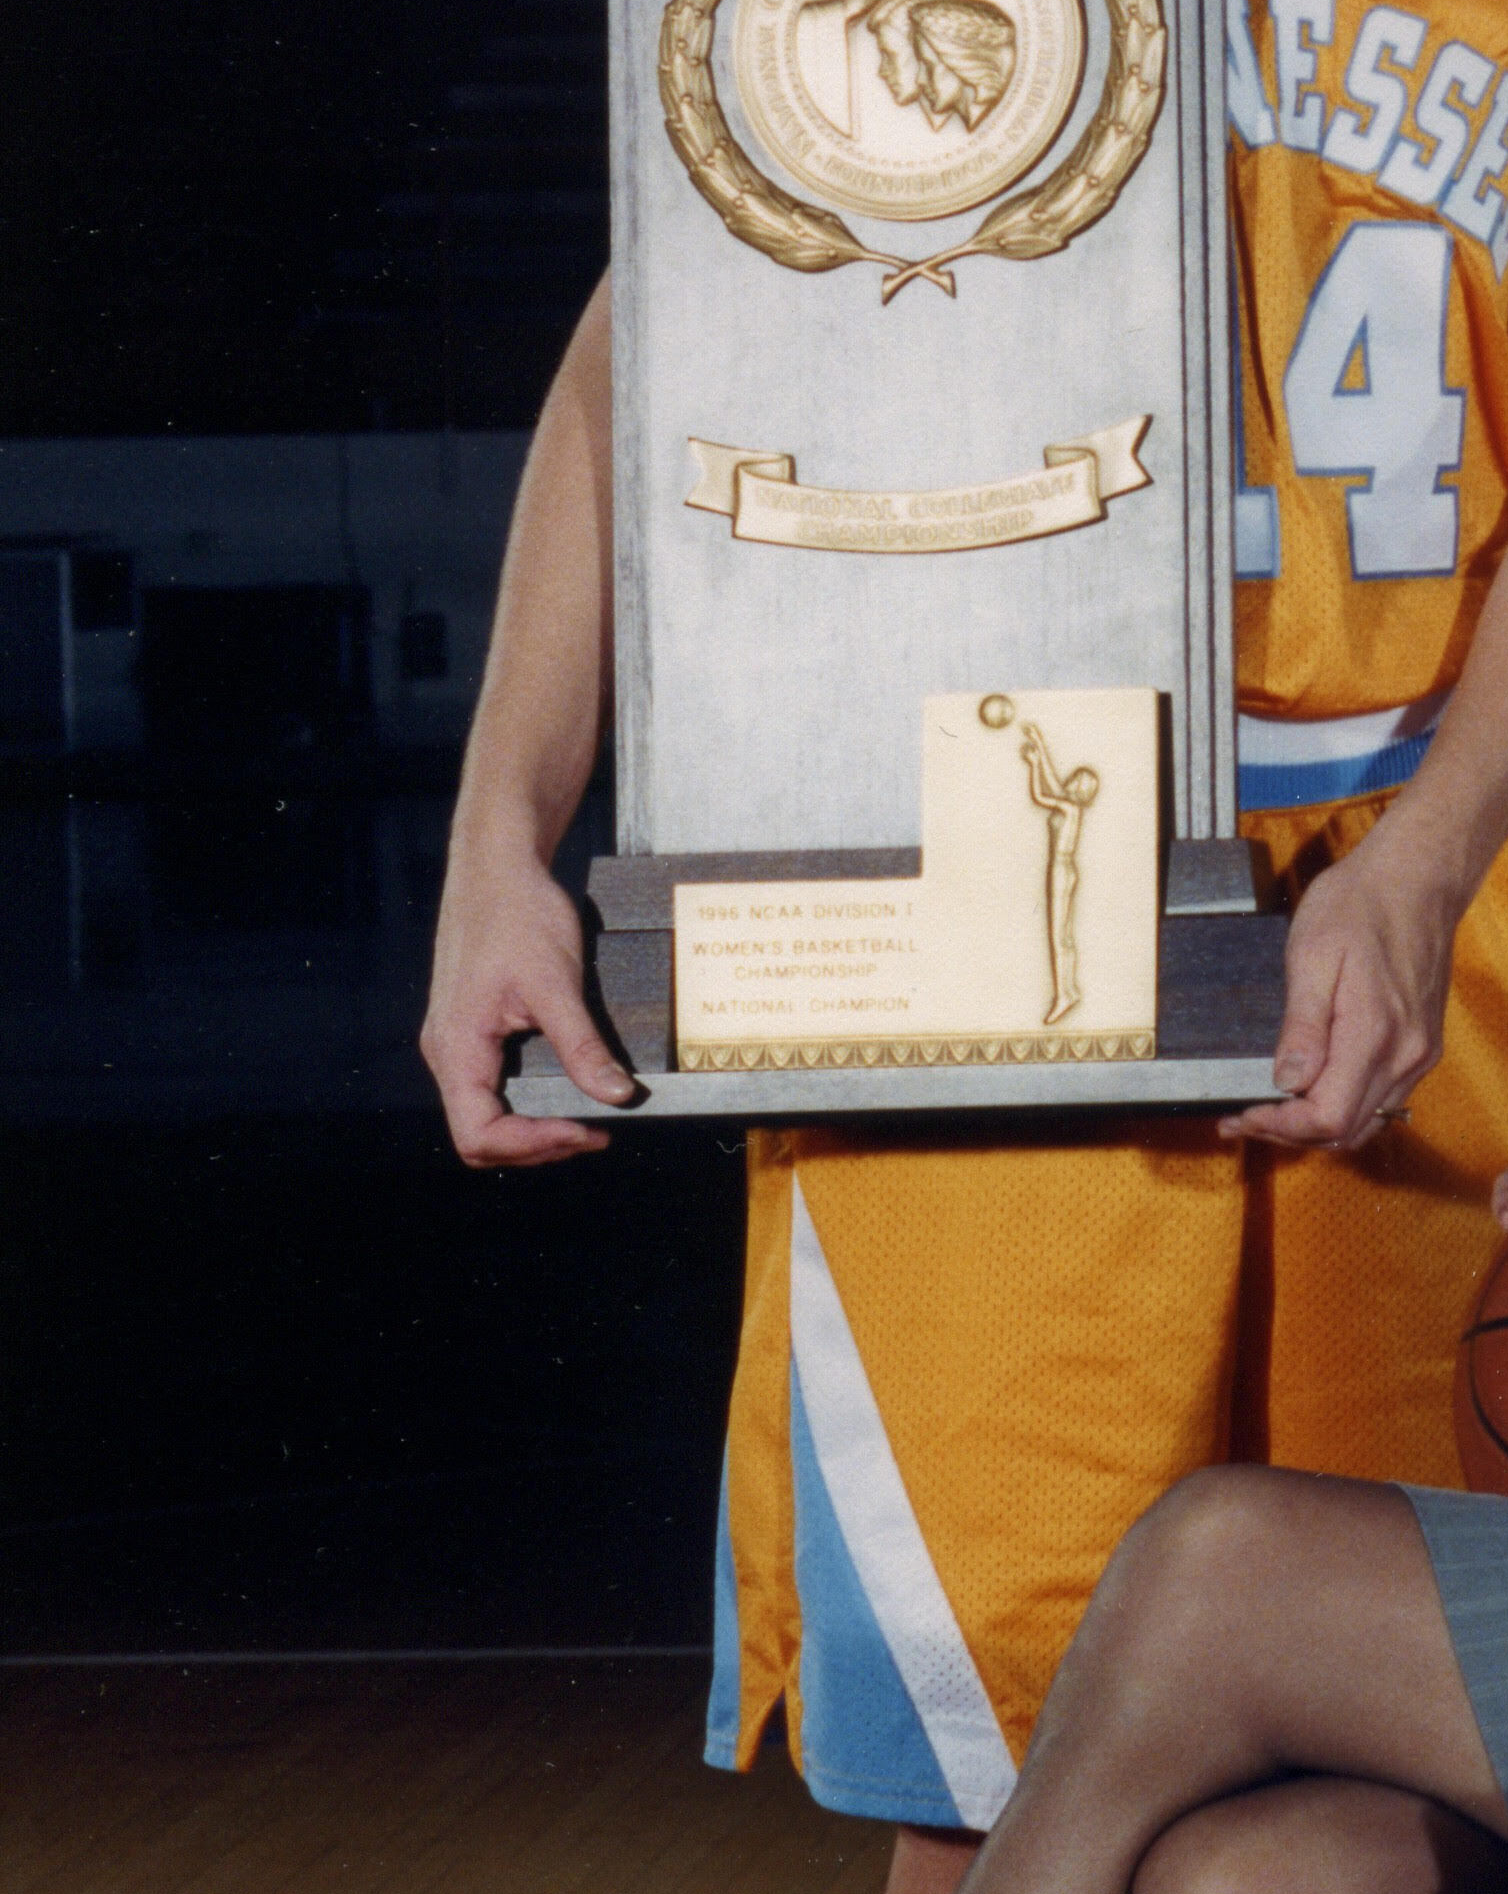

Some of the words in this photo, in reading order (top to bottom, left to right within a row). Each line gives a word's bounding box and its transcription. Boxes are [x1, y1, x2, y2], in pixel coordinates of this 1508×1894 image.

[749, 904, 804, 920] NCAA
[812, 903, 897, 920] DIVISION
[692, 939, 784, 957] WOMEN'S
[791, 938, 919, 956] BASKETBALL
[734, 962, 878, 981] CHAMPIONSHIP
[701, 999, 794, 1016] NATIONAL
[808, 996, 911, 1014] CHAMPION
